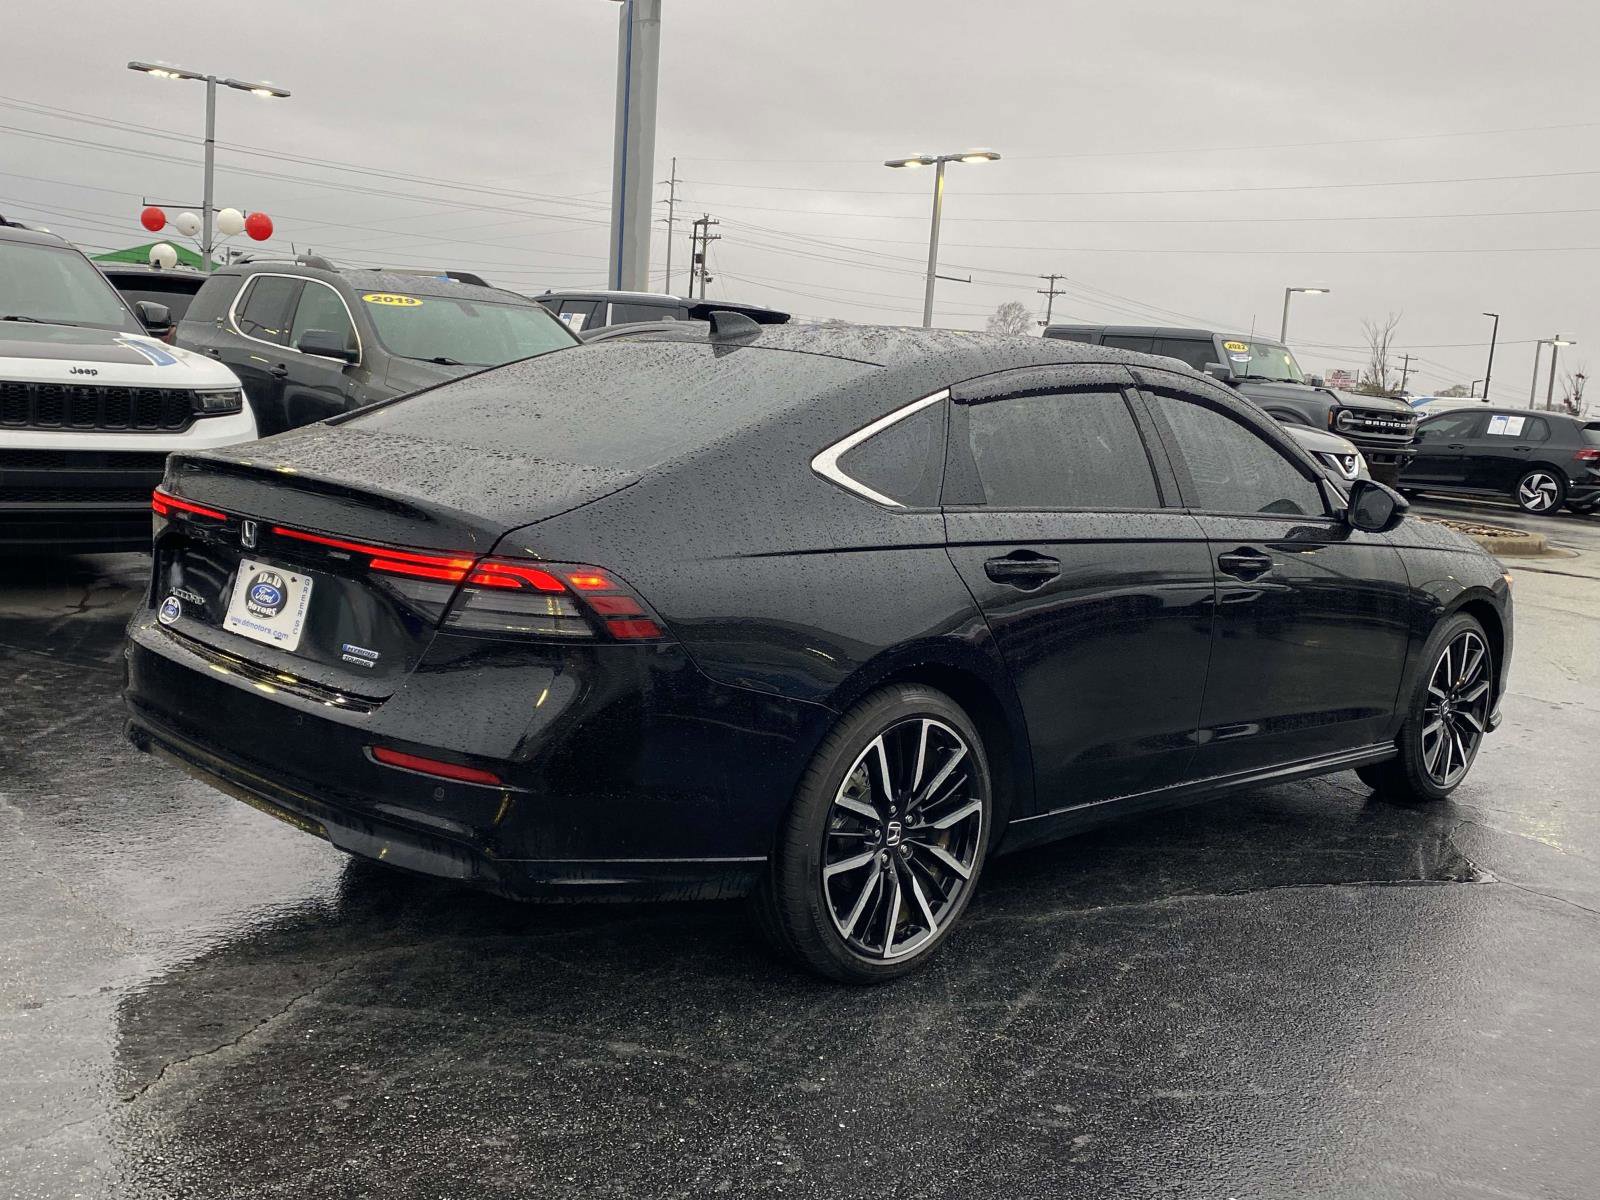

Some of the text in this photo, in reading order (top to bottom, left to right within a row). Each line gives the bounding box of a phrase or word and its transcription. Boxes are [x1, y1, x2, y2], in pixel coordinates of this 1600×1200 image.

[371, 295, 415, 304] 2019
[70, 366, 98, 376] Jeep
[1365, 420, 1407, 428] BRONCO
[255, 586, 276, 604] Ford
[247, 599, 277, 616] MOTORS
[347, 645, 377, 658] HYBRID
